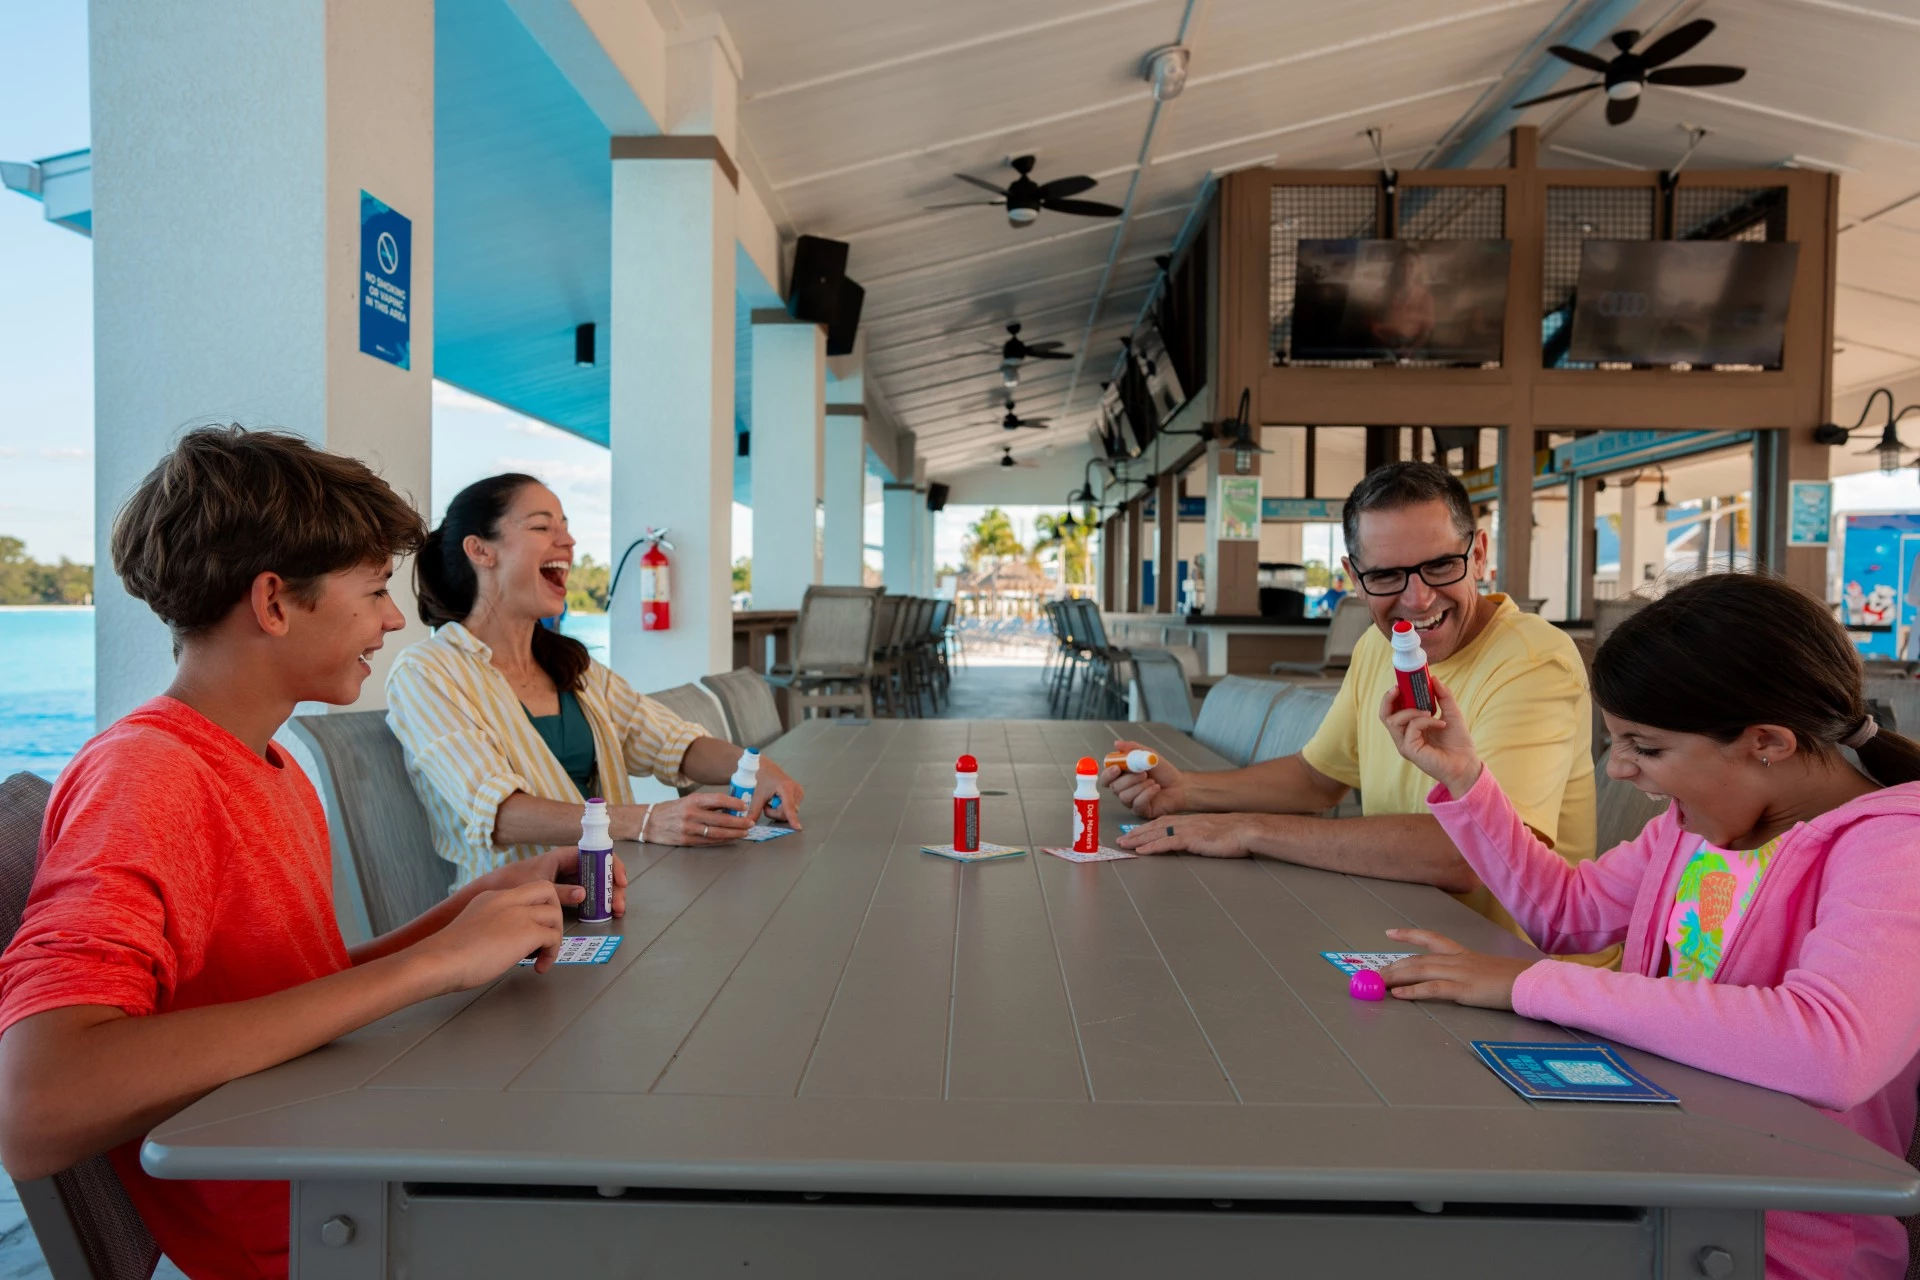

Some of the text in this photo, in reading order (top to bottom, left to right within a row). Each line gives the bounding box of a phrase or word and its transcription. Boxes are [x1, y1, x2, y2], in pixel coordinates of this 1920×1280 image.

[365, 271, 406, 300] NO SMOKING
[368, 285, 404, 310] OR VAPING
[365, 295, 406, 323] IN THIS AREA
[1506, 1058, 1546, 1084] SCAN FOR
[1517, 1054, 1545, 1071] MENU
